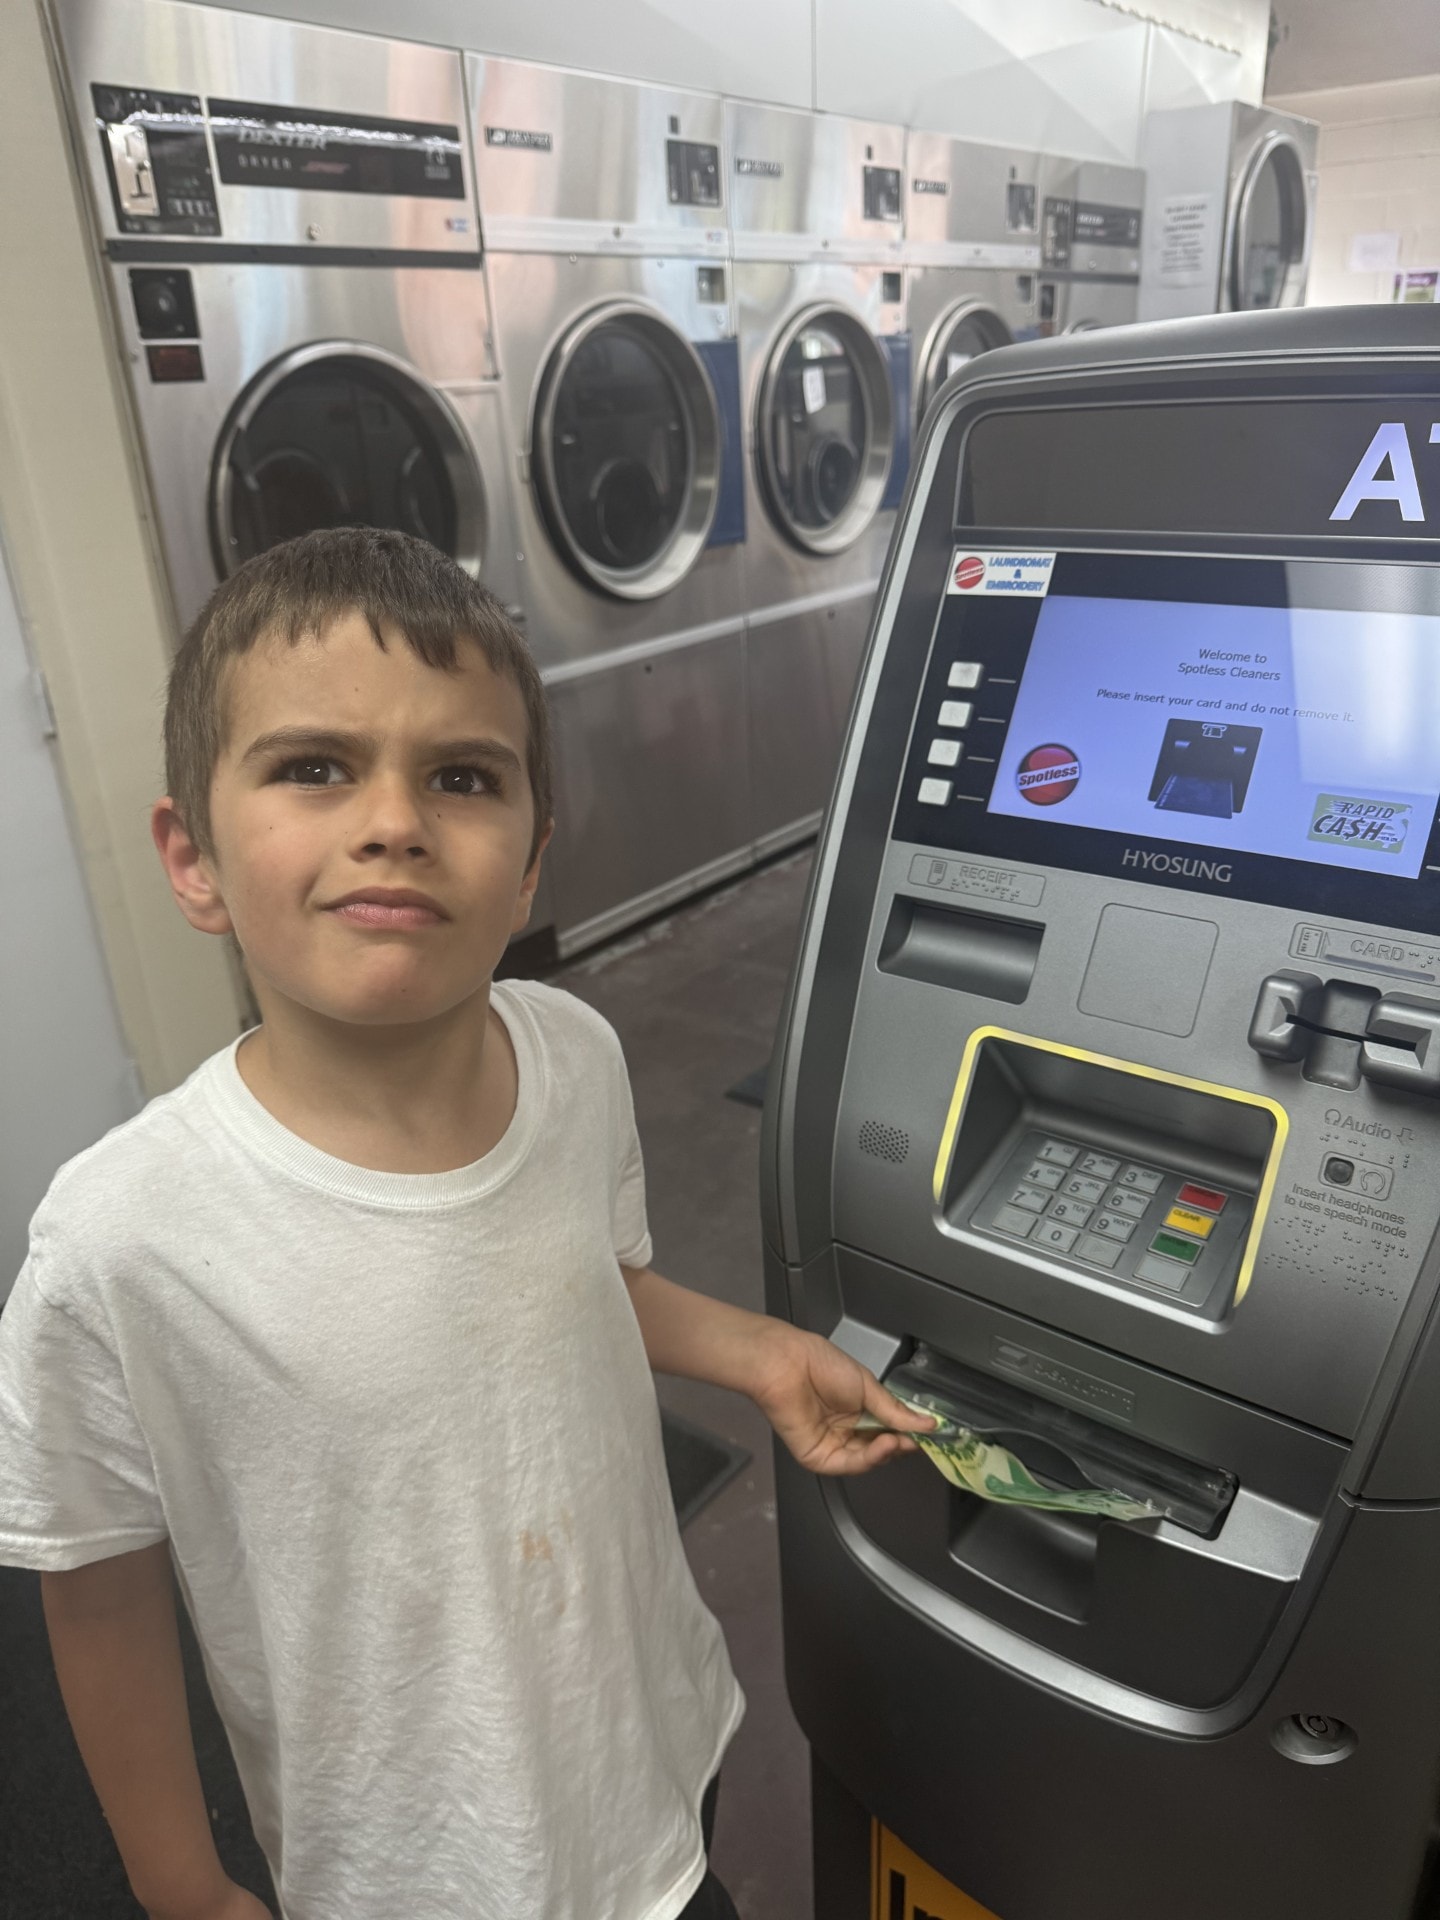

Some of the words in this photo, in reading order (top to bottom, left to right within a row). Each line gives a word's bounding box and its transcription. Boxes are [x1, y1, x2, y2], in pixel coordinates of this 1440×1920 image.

[988, 557, 1053, 568] LAUNDROMAT
[1199, 648, 1251, 663] Welcome
[1255, 652, 1268, 664] to
[1177, 662, 1226, 676] Spotless
[1230, 666, 1281, 682] Cleaners
[1096, 688, 1131, 701] Please
[1133, 691, 1165, 704] insert
[1168, 694, 1193, 706] your
[1196, 698, 1222, 709] card
[1225, 701, 1247, 713] and
[1250, 703, 1266, 715] do
[1269, 706, 1290, 717] not
[1293, 709, 1339, 721] remove
[1019, 766, 1078, 786] Spotless
[1338, 801, 1395, 819] RAPID
[1122, 849, 1233, 883] HYOSUNG
[960, 865, 1017, 886] RECEIPT
[1350, 939, 1405, 961] CARD
[1340, 1115, 1392, 1140] Audio
[1044, 1146, 1053, 1157] 1
[1083, 1159, 1096, 1171] 2
[1029, 1168, 1041, 1180] 4
[1124, 1171, 1137, 1183] 3
[1069, 1181, 1082, 1193] 5
[1014, 1190, 1026, 1202] 7
[1111, 1194, 1124, 1206] 6
[1054, 1204, 1068, 1216] 8
[1292, 1183, 1327, 1202] Insert
[1328, 1193, 1406, 1226] headphones
[1172, 1209, 1202, 1223] CLEAR
[1284, 1194, 1297, 1206] to
[1299, 1199, 1322, 1214] use
[1323, 1207, 1369, 1229] speech
[1371, 1219, 1408, 1240] mode
[1096, 1218, 1110, 1230] 9
[1050, 1229, 1063, 1241] 0
